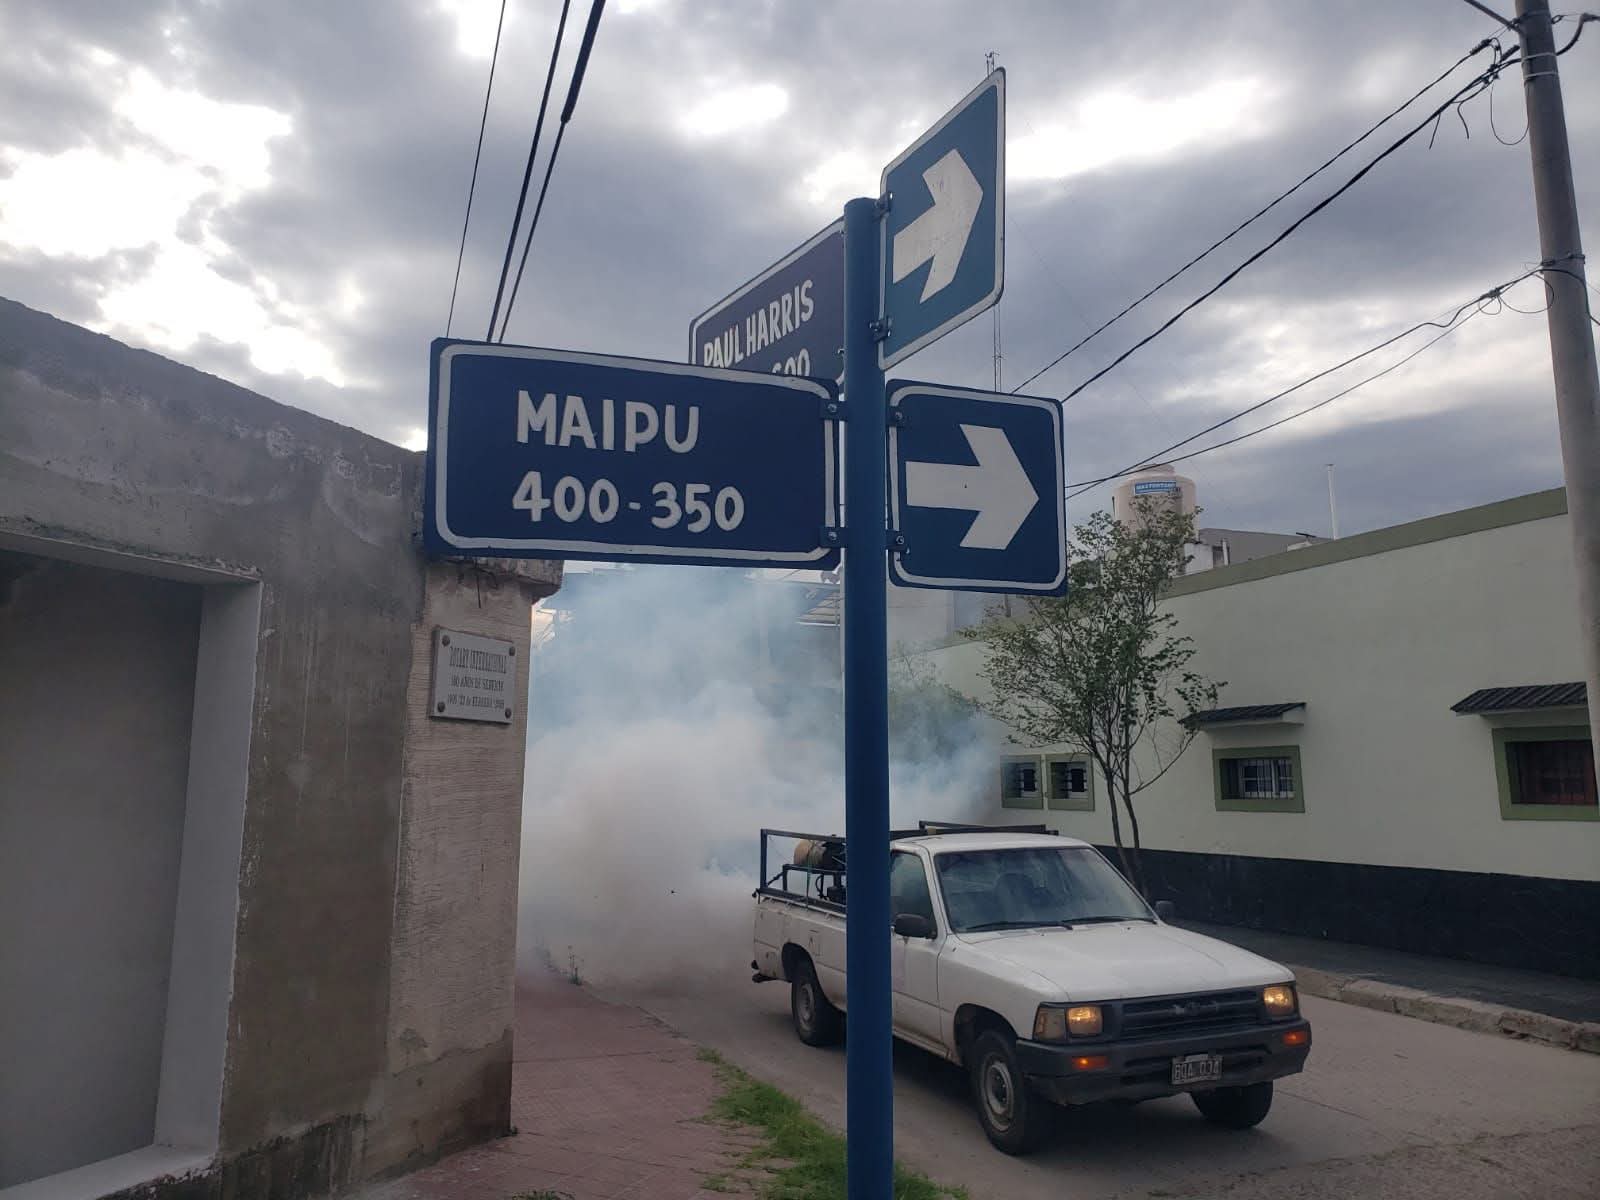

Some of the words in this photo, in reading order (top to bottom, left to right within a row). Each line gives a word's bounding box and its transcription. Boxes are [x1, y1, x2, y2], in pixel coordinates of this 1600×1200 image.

[704, 325, 744, 368] PAUL
[746, 280, 814, 357] HARRIS
[517, 390, 699, 453] MAIPU
